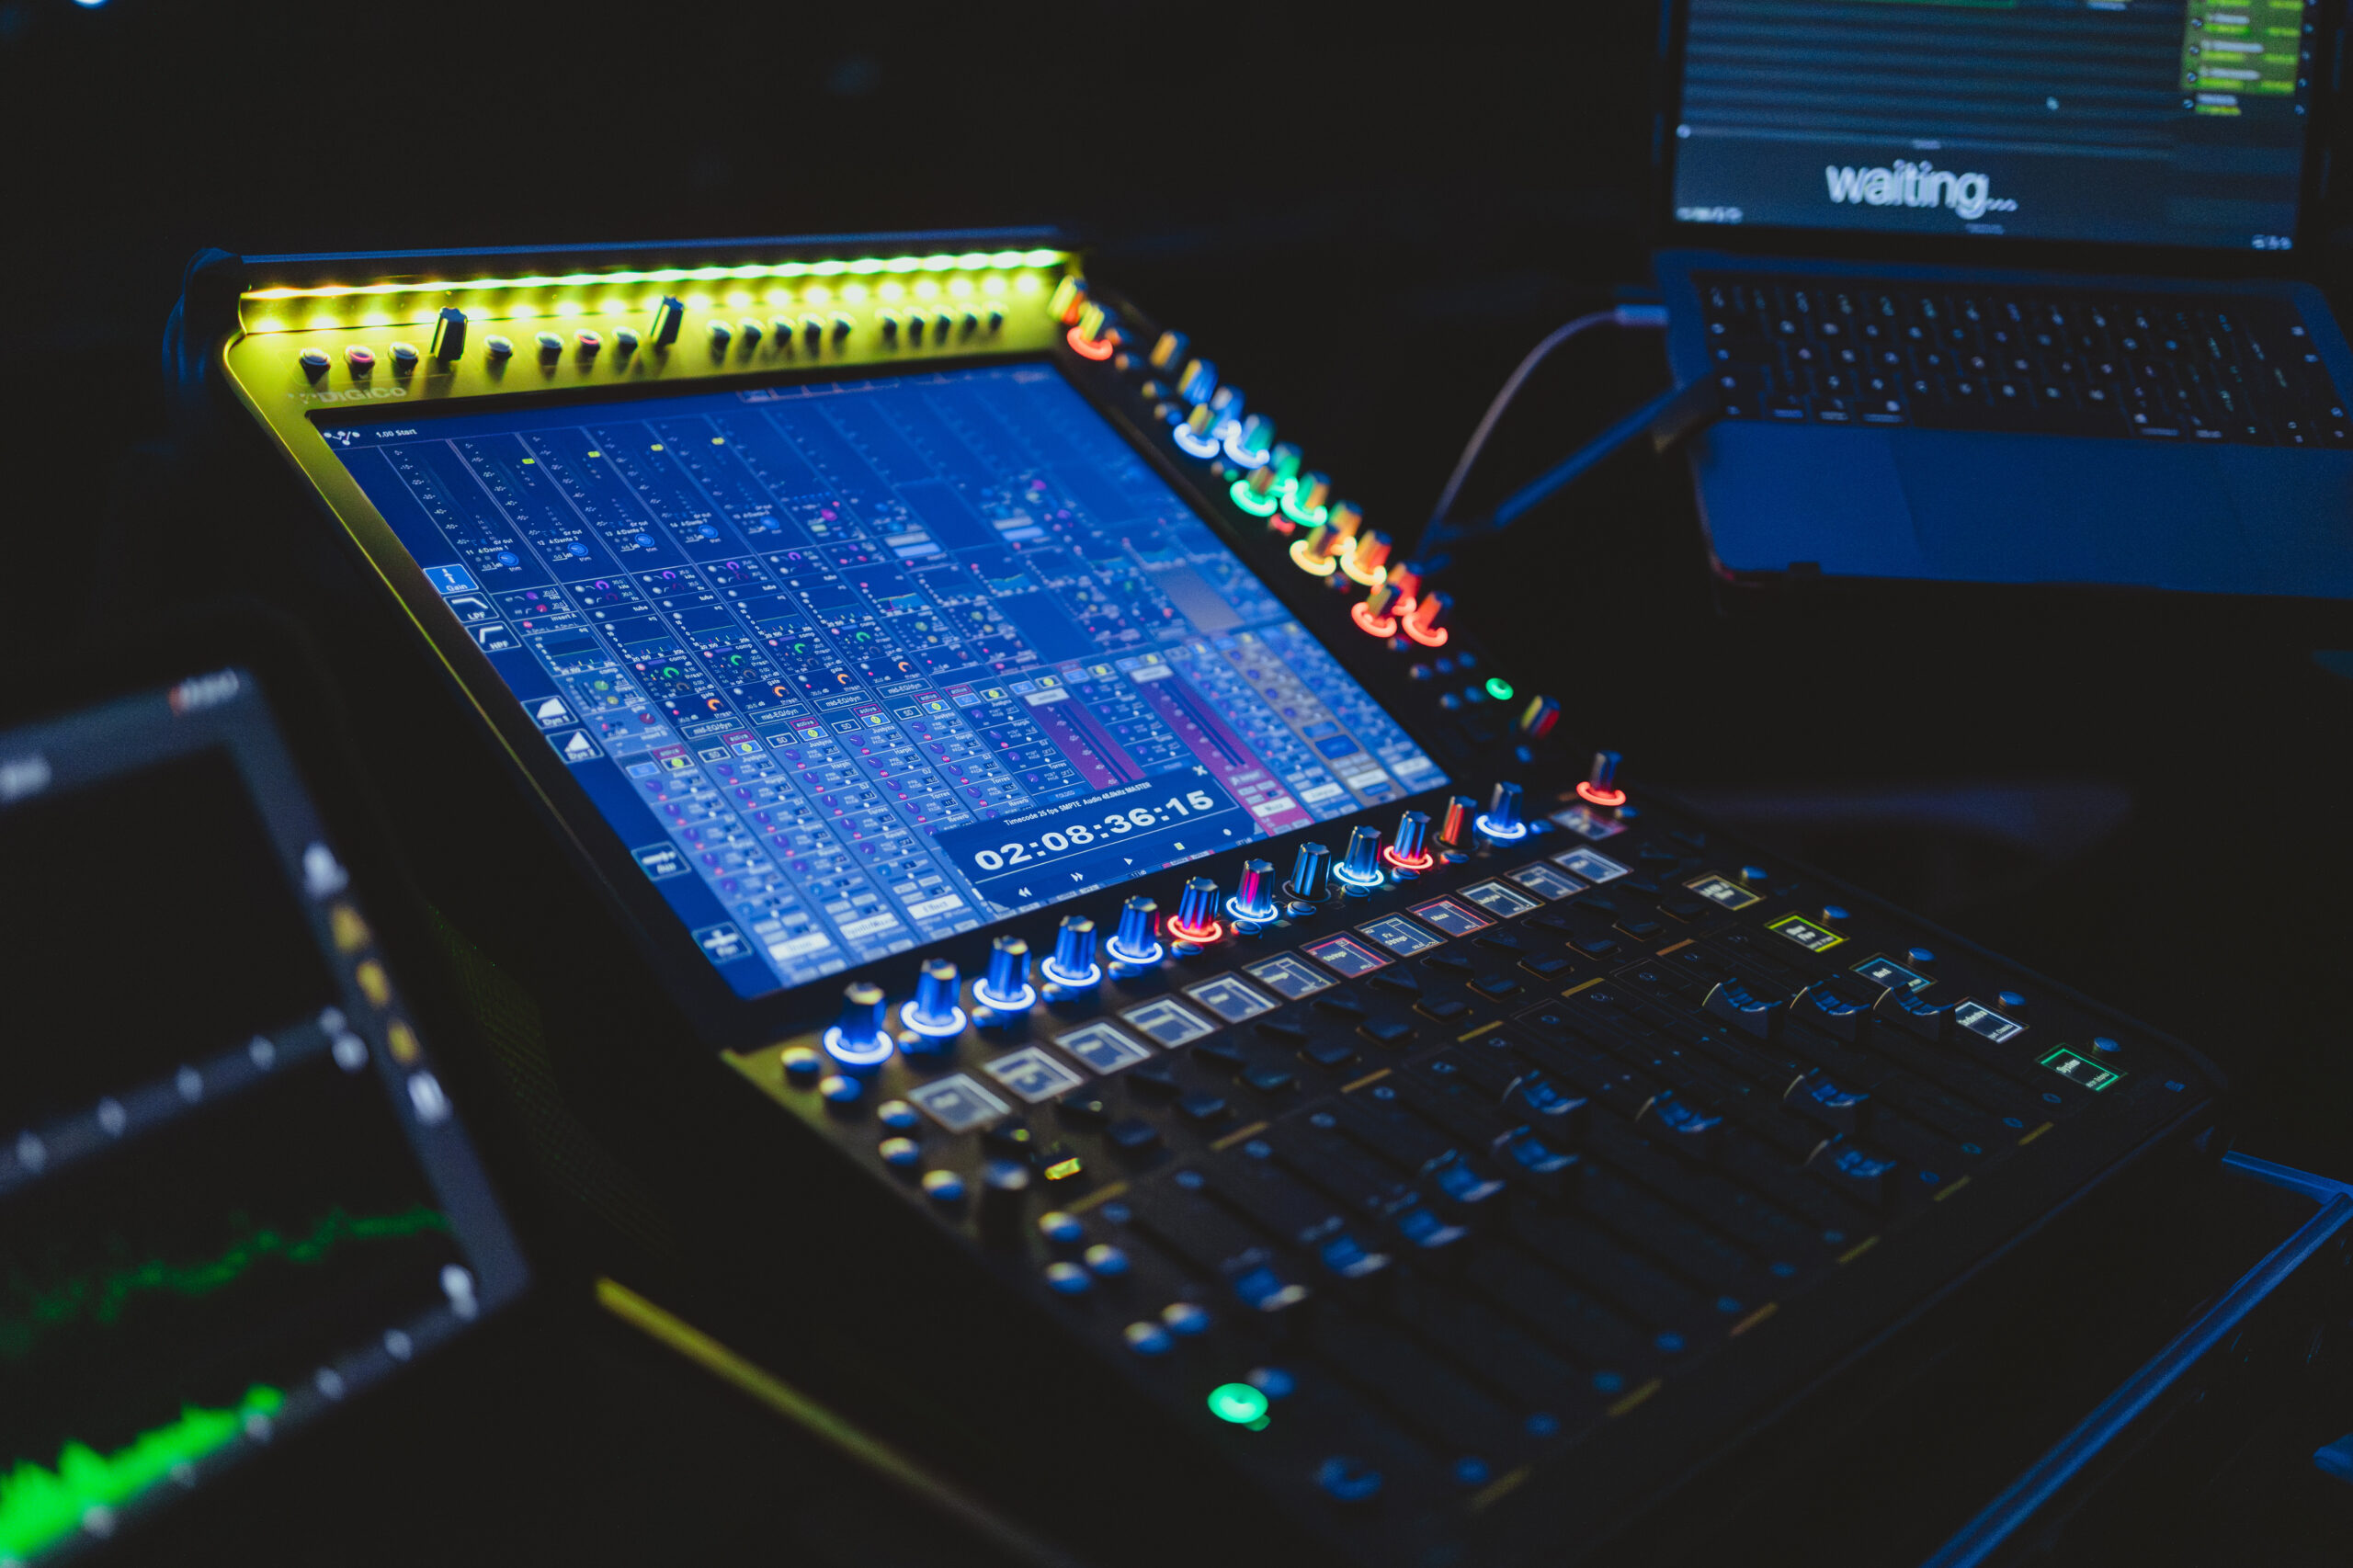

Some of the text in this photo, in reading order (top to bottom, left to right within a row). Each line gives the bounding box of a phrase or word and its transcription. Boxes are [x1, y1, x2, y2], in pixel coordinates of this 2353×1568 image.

[1826, 158, 2018, 220] waiting...
[375, 428, 418, 439] 1.00 Start
[446, 584, 468, 592] Gain
[467, 611, 485, 620] LPF
[489, 641, 509, 650] HPF
[825, 695, 861, 707] mid-EQ/dyn
[761, 709, 799, 721] mid-EQ/dyn
[933, 711, 956, 720] Justyna
[541, 717, 563, 726] Dyn
[872, 725, 895, 733] Justyna
[809, 739, 833, 748] Justyna
[991, 776, 1011, 785] Torres
[930, 791, 950, 800] Torres
[1004, 813, 1039, 827] Timecode
[1047, 807, 1060, 816] fps
[1059, 801, 1082, 812] SMPTE
[1083, 796, 1103, 805] Audio
[1126, 782, 1153, 794] MASTER
[1009, 798, 1029, 806] Reverb
[948, 813, 970, 822] Reverb
[973, 790, 1214, 871] 02:08:36:15
[1384, 936, 1408, 946] Strings
[2055, 1059, 2081, 1074] System
